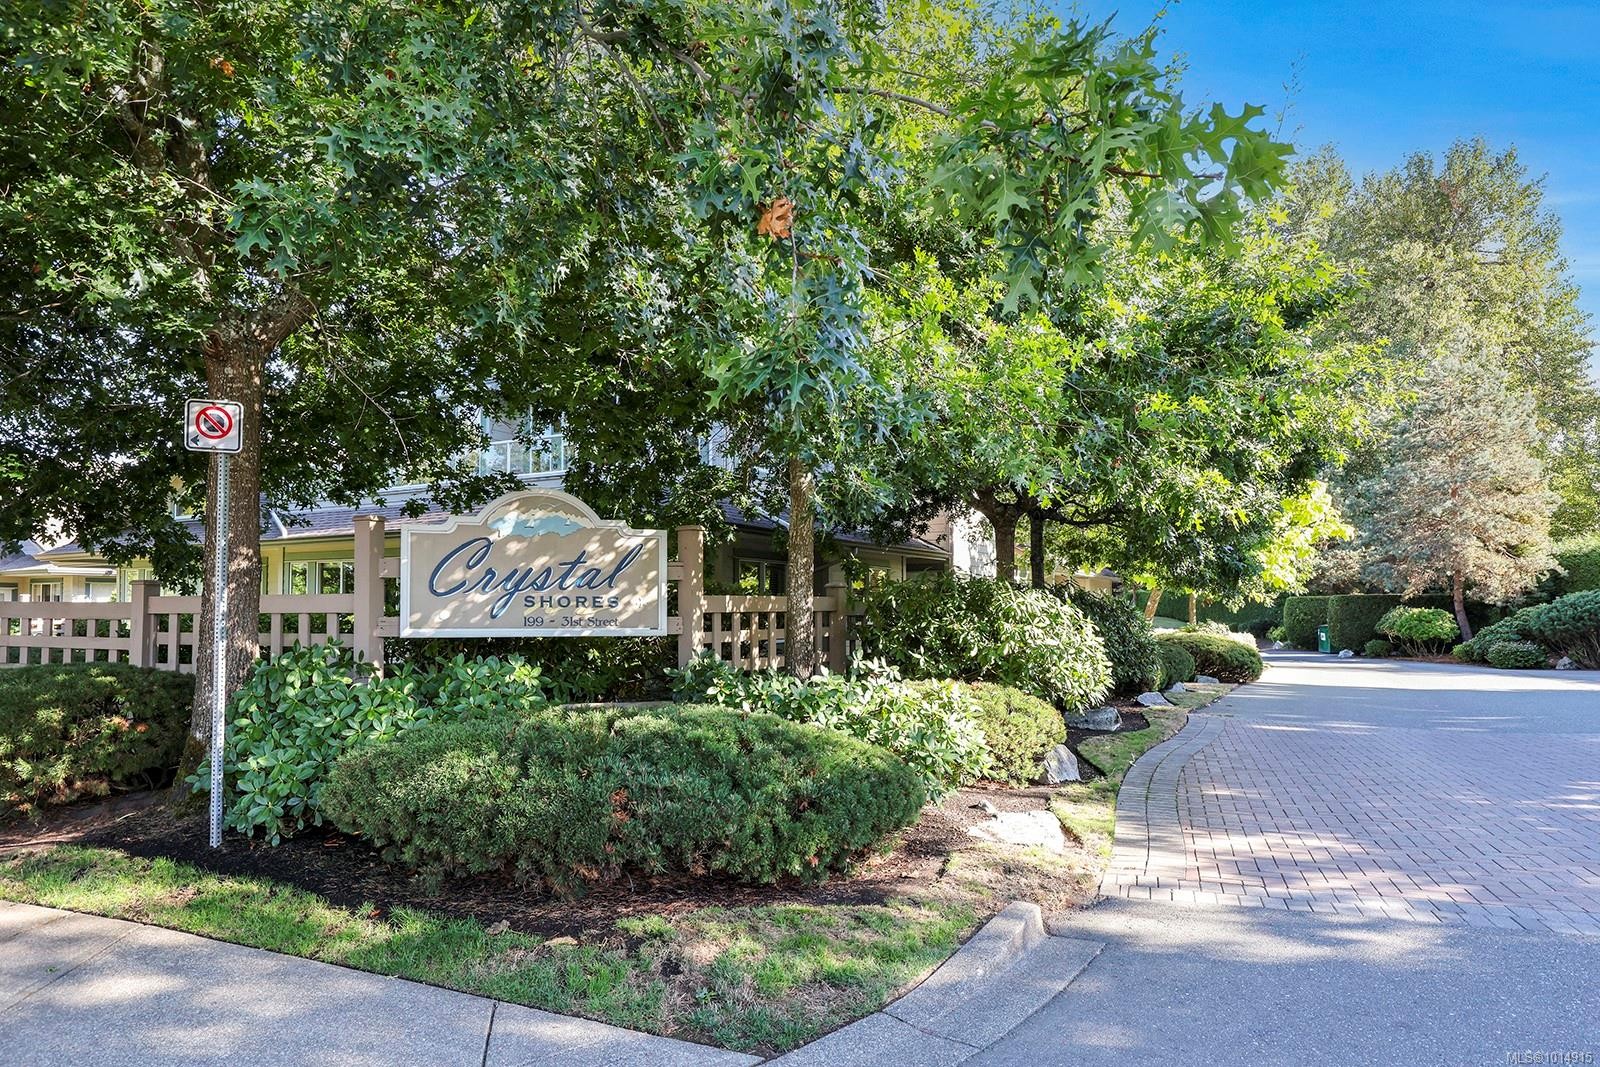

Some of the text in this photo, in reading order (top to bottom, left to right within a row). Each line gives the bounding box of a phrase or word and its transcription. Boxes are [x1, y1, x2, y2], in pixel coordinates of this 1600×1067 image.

[428, 536, 644, 619] Crystal
[523, 595, 620, 609] SHORES
[523, 616, 544, 627] 199
[561, 616, 583, 627] 31st
[587, 616, 619, 628] Street
